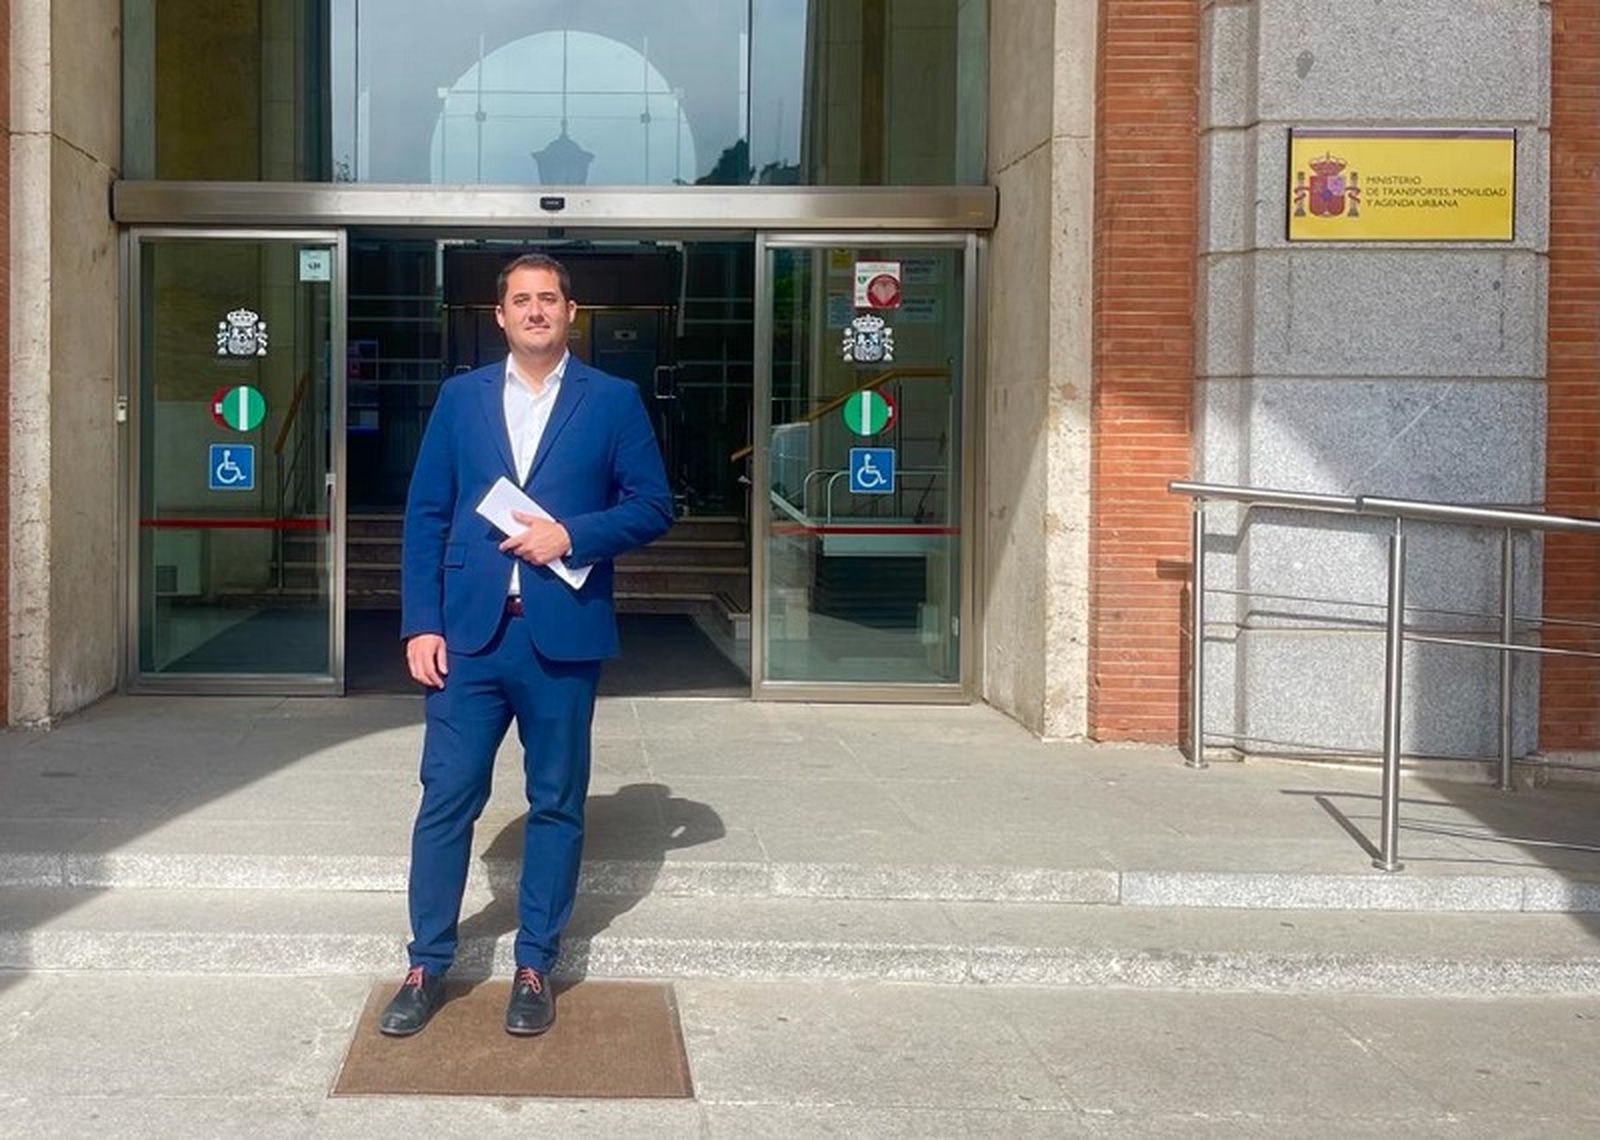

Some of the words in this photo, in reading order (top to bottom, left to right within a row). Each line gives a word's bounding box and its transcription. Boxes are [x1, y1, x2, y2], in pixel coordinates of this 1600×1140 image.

[1366, 176, 1421, 185] MINISTERIO
[1366, 187, 1379, 196] DE
[1453, 187, 1507, 197] MOVILIDAD
[1373, 199, 1415, 208] AGENDA
[1417, 199, 1459, 208] URBANA
